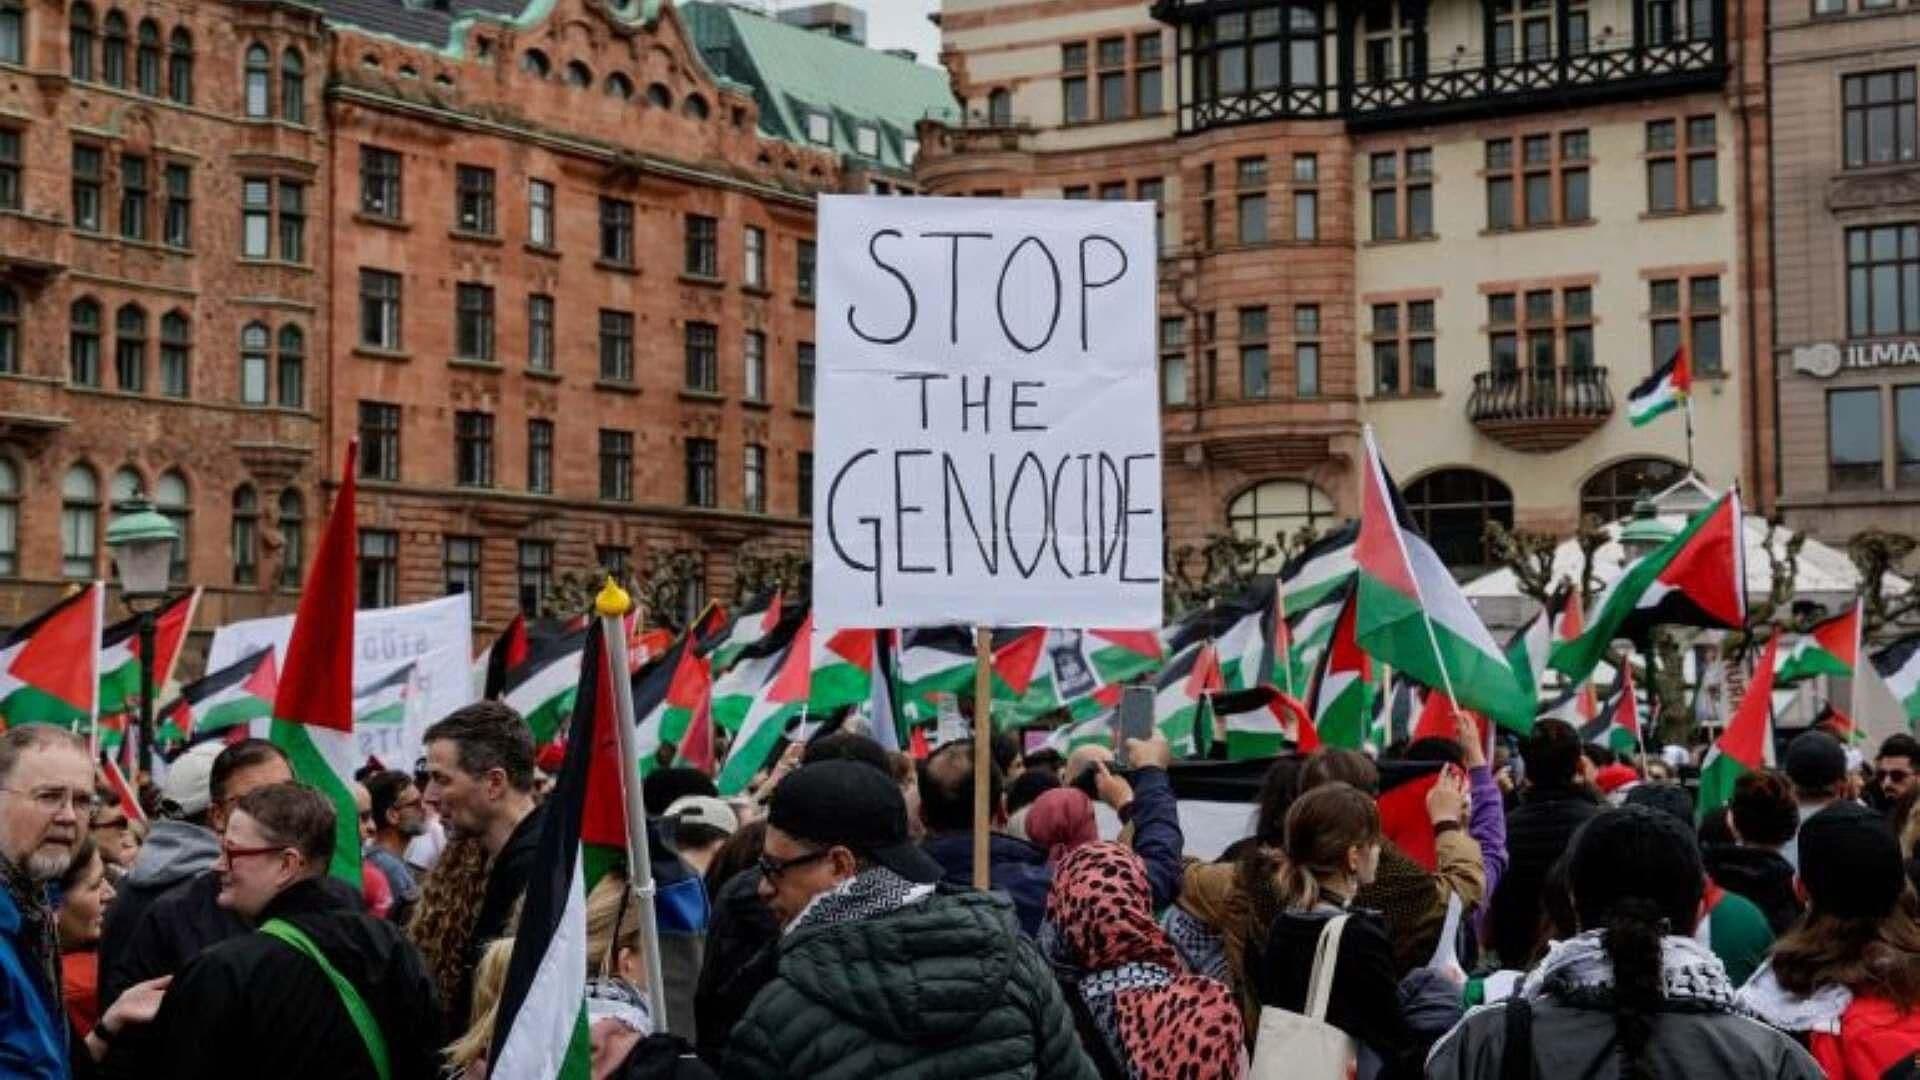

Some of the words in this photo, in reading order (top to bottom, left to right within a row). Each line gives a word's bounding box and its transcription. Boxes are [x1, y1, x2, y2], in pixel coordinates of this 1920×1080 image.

[847, 228, 1128, 353] STOP
[1848, 341, 1920, 367] ILMA
[895, 373, 1048, 434] THE
[827, 447, 1161, 607] GENOCIDE
